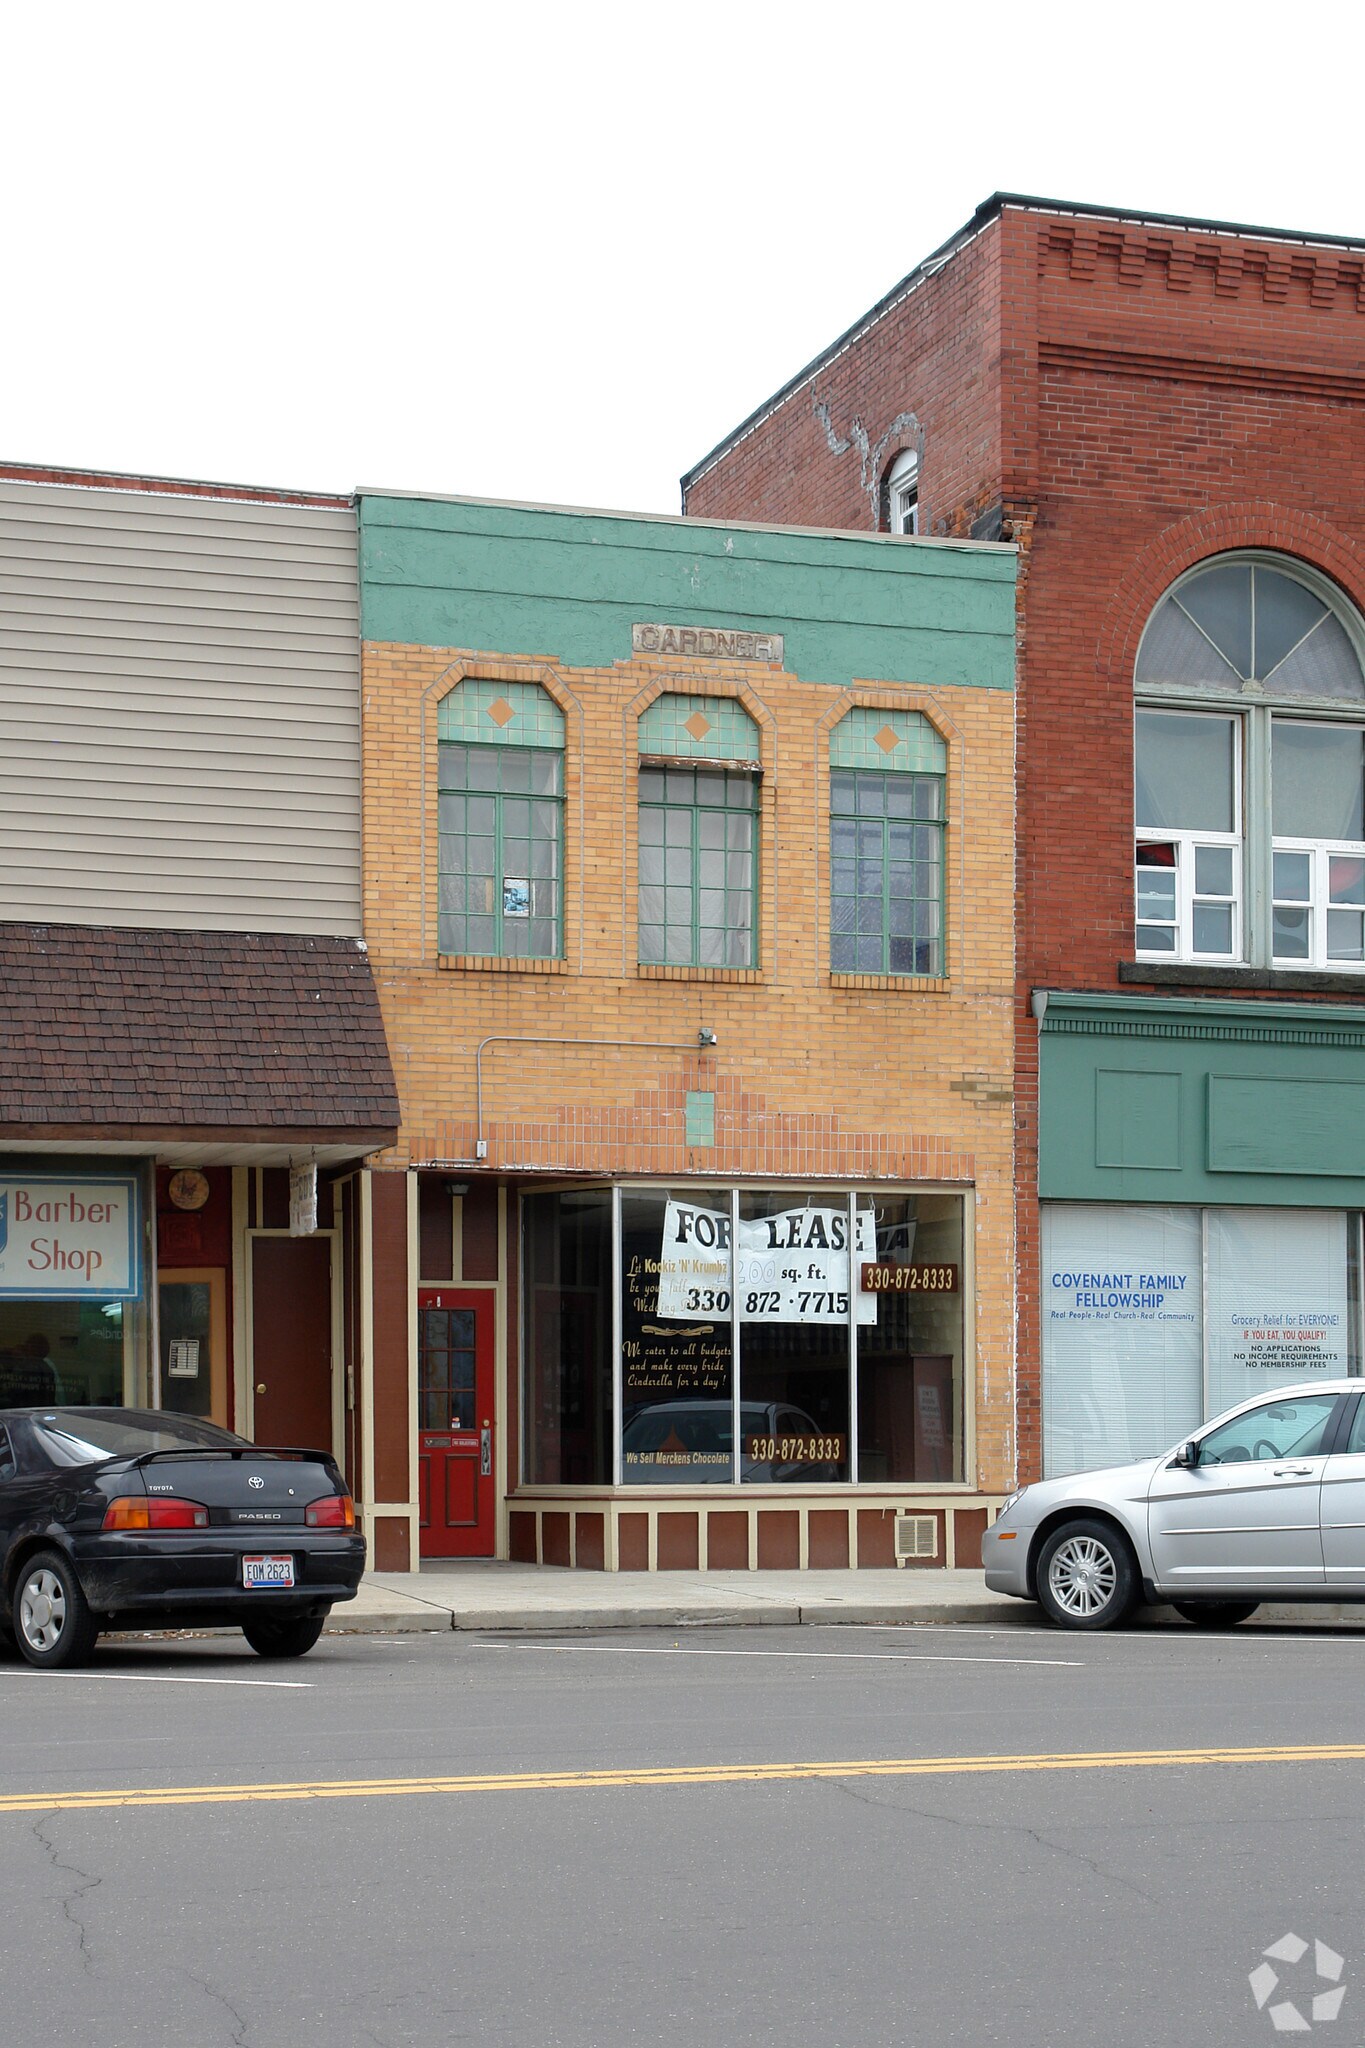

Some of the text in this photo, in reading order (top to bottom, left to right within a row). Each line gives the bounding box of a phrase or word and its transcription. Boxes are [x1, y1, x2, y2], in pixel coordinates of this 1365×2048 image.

[15, 1190, 119, 1223] Barber
[675, 1208, 740, 1250] FOR
[764, 1214, 864, 1251] LEASE
[27, 1238, 102, 1281] Shop
[626, 1255, 642, 1277] Let
[644, 1258, 676, 1273] Kookiz
[807, 1263, 827, 1279] ft.
[866, 1267, 953, 1289] 330-872-8333
[629, 1278, 640, 1293] be
[1052, 1273, 1187, 1290] COVENANT FAMILY
[1076, 1293, 1164, 1308] FELLOWSHIP
[1051, 1311, 1066, 1319] Real
[1158, 1312, 1195, 1322] Community
[1231, 1314, 1340, 1327] Grocery Relief for EVERYONE!
[1243, 1330, 1249, 1340] IF
[1252, 1330, 1265, 1340] YOU
[1283, 1330, 1296, 1340] YOU
[1298, 1330, 1327, 1341] QUALIFY!
[622, 1341, 732, 1358] We cater to all budgets
[629, 1358, 724, 1374] and make every bride
[627, 1374, 673, 1386] Cinderella
[676, 1374, 689, 1389] for
[751, 1438, 840, 1460] 330-872-8333
[626, 1452, 730, 1464] We Sell Merckens Chocolate
[267, 1564, 291, 1580] 2623
